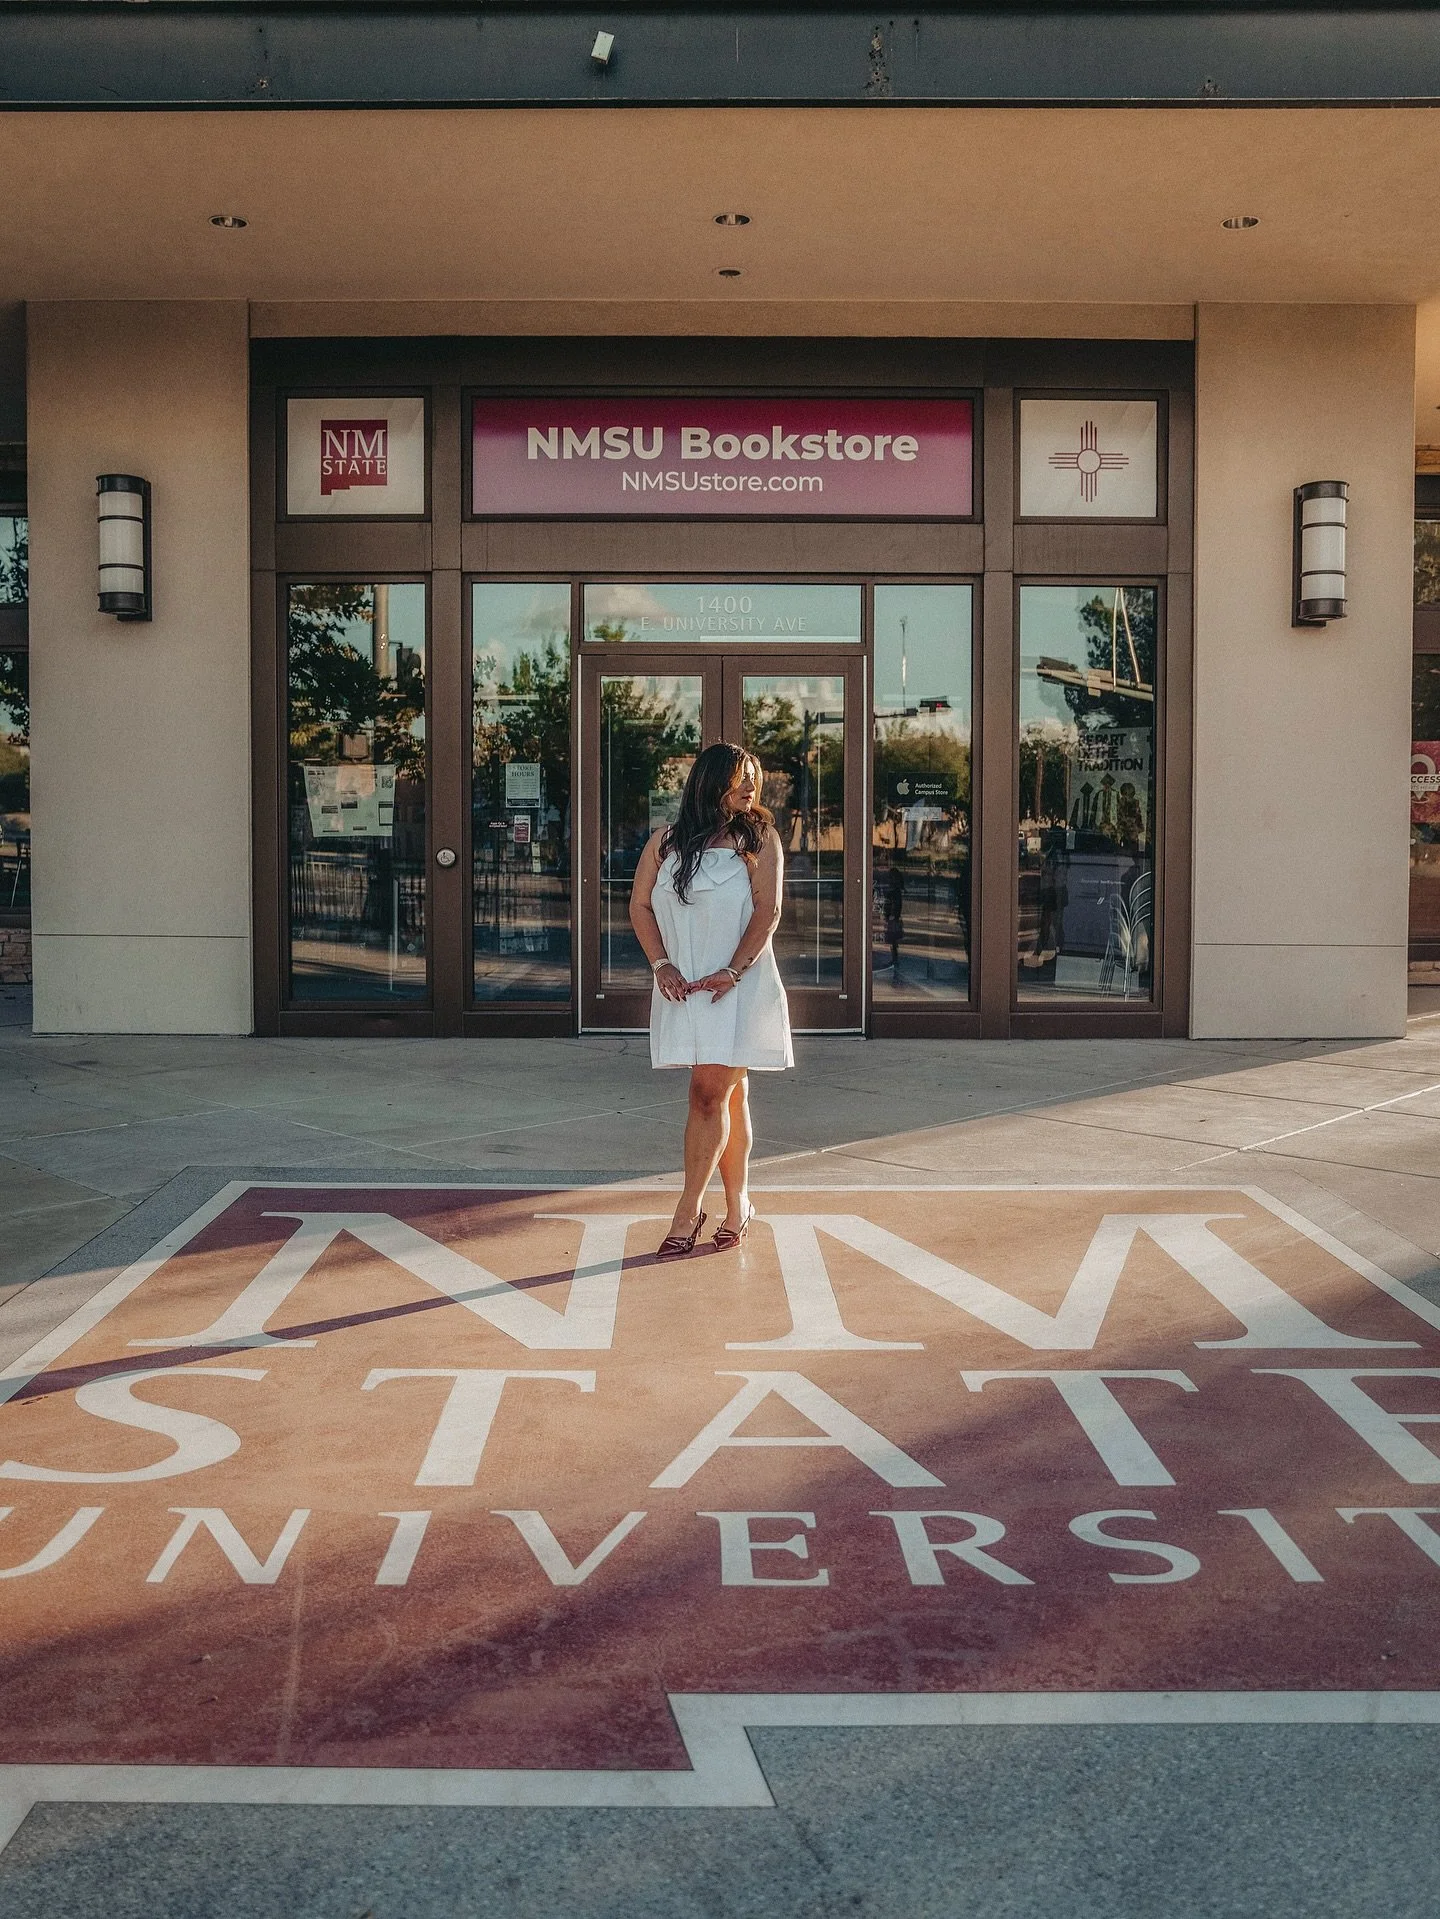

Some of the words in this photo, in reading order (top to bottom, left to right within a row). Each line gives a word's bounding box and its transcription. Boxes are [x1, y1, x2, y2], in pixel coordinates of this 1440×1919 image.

[322, 430, 386, 458] NM
[527, 426, 664, 460] NMSU
[681, 425, 919, 461] Bookstore
[322, 460, 387, 475] STATE
[622, 471, 823, 491] NMSUstore.com
[698, 596, 752, 614] 1400
[641, 616, 655, 631] E.
[664, 617, 766, 632] UNIVERSITY
[773, 617, 807, 632] AVE
[1095, 733, 1127, 746] PART
[1077, 759, 1143, 771] TRADITION
[126, 1211, 1422, 1350] NM
[0, 1367, 1440, 1488] STATE
